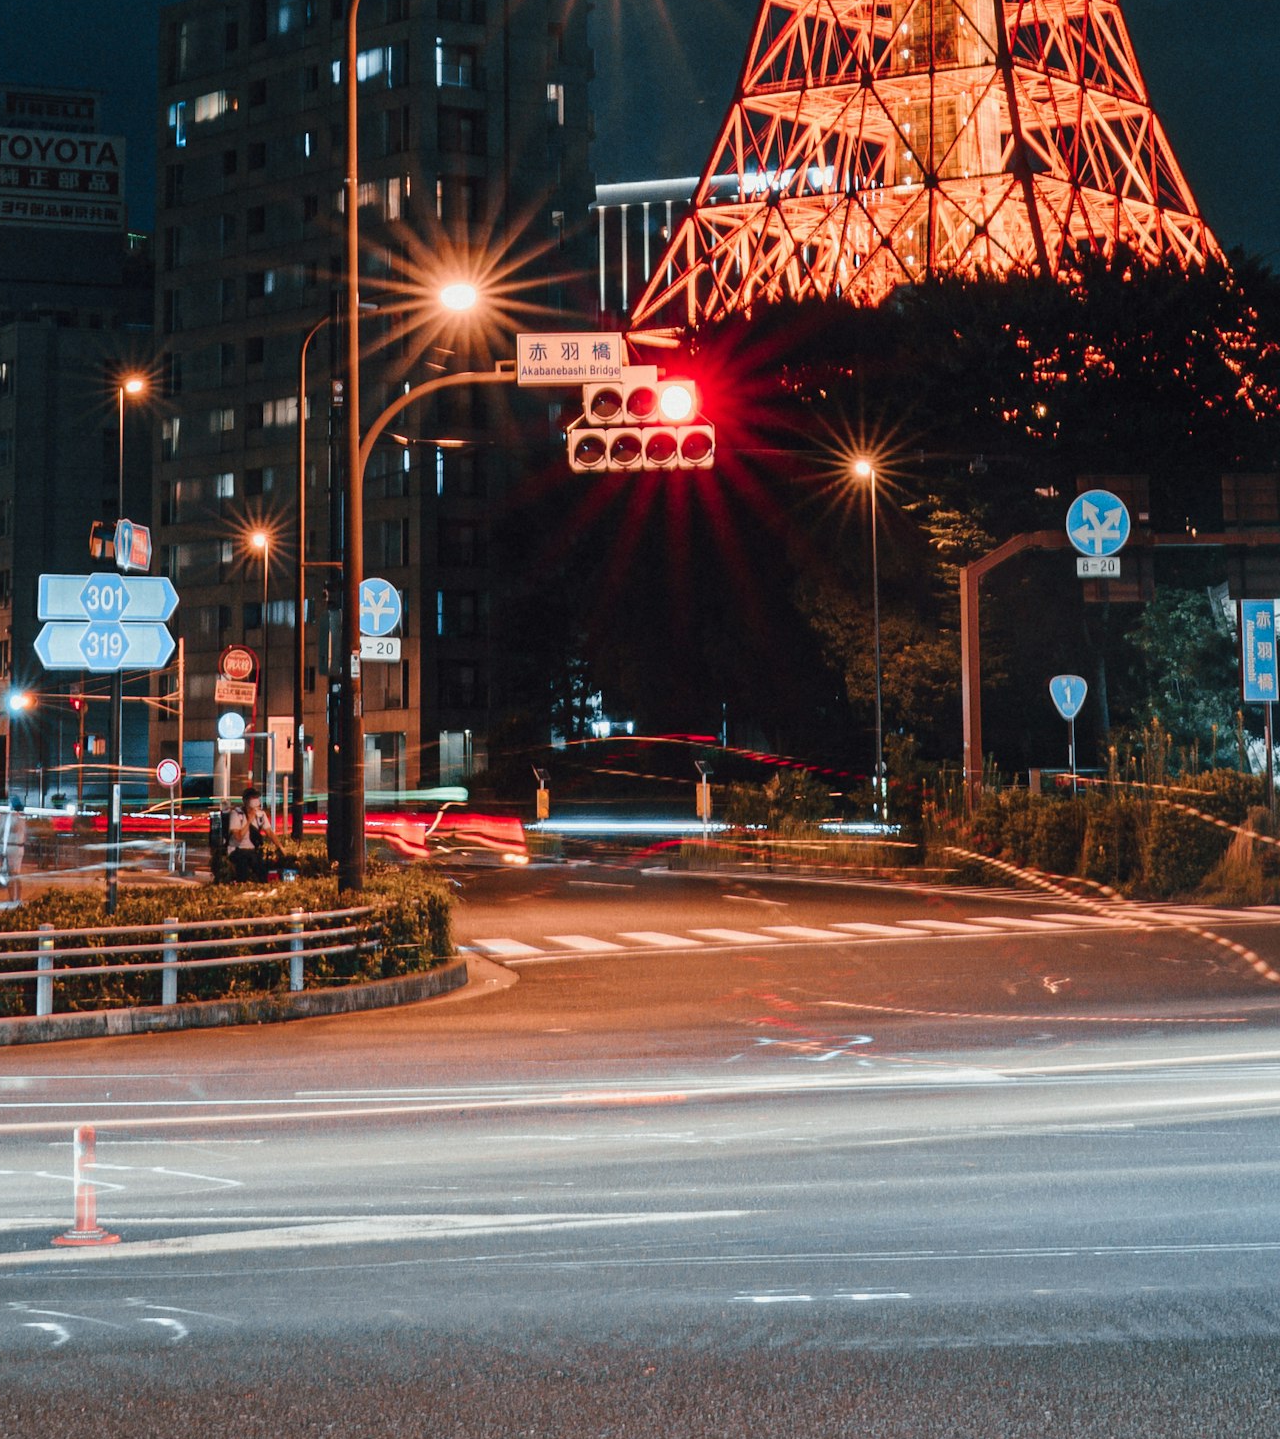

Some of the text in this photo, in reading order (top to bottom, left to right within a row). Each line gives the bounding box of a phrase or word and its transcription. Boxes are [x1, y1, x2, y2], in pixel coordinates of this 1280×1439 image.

[529, 342, 611, 361] 赤羽橋
[522, 365, 620, 378] Akabanebashi Bridge
[1082, 559, 1115, 573] 8-20
[87, 586, 122, 610] 301
[86, 632, 122, 657] 319
[1256, 611, 1273, 691] 赤羽橋
